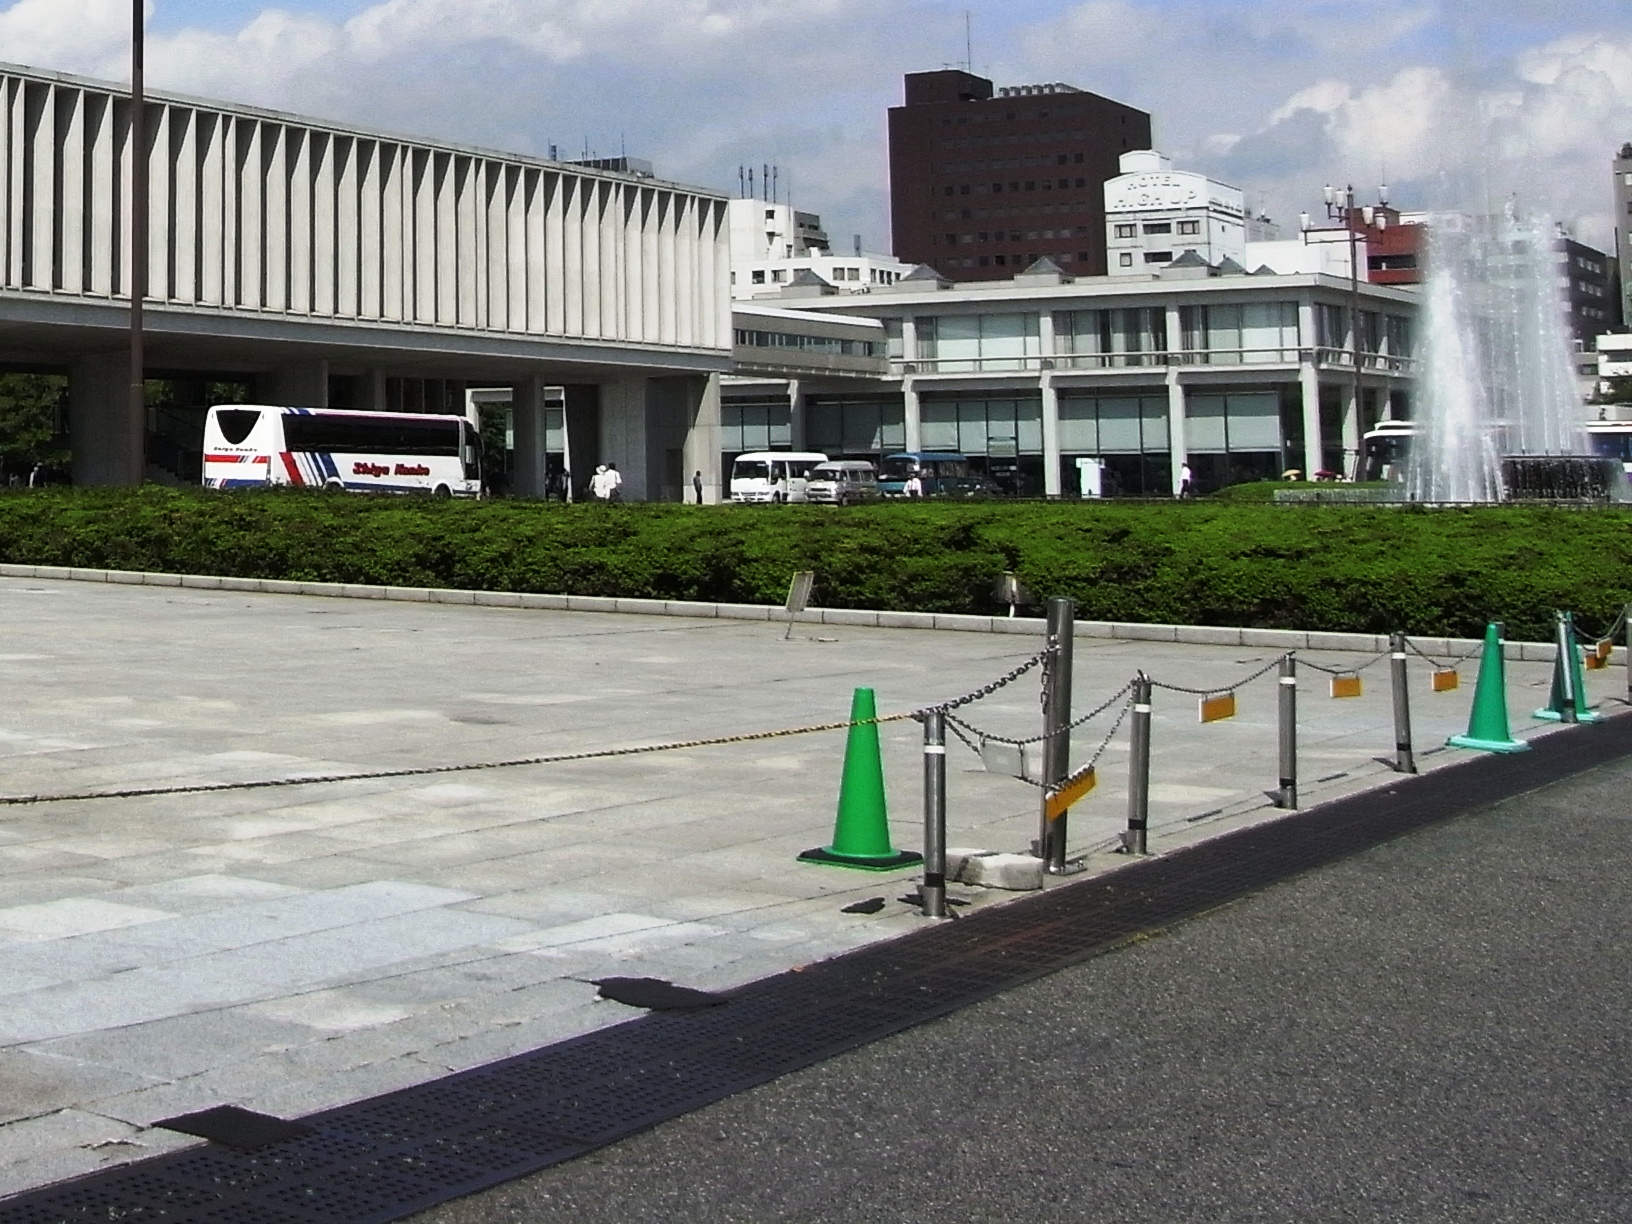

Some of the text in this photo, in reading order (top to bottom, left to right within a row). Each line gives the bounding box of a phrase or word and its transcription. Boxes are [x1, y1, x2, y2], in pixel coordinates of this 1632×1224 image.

[1126, 174, 1181, 191] HOTEL
[1113, 189, 1164, 209] HIGH
[1169, 187, 1198, 205] UP
